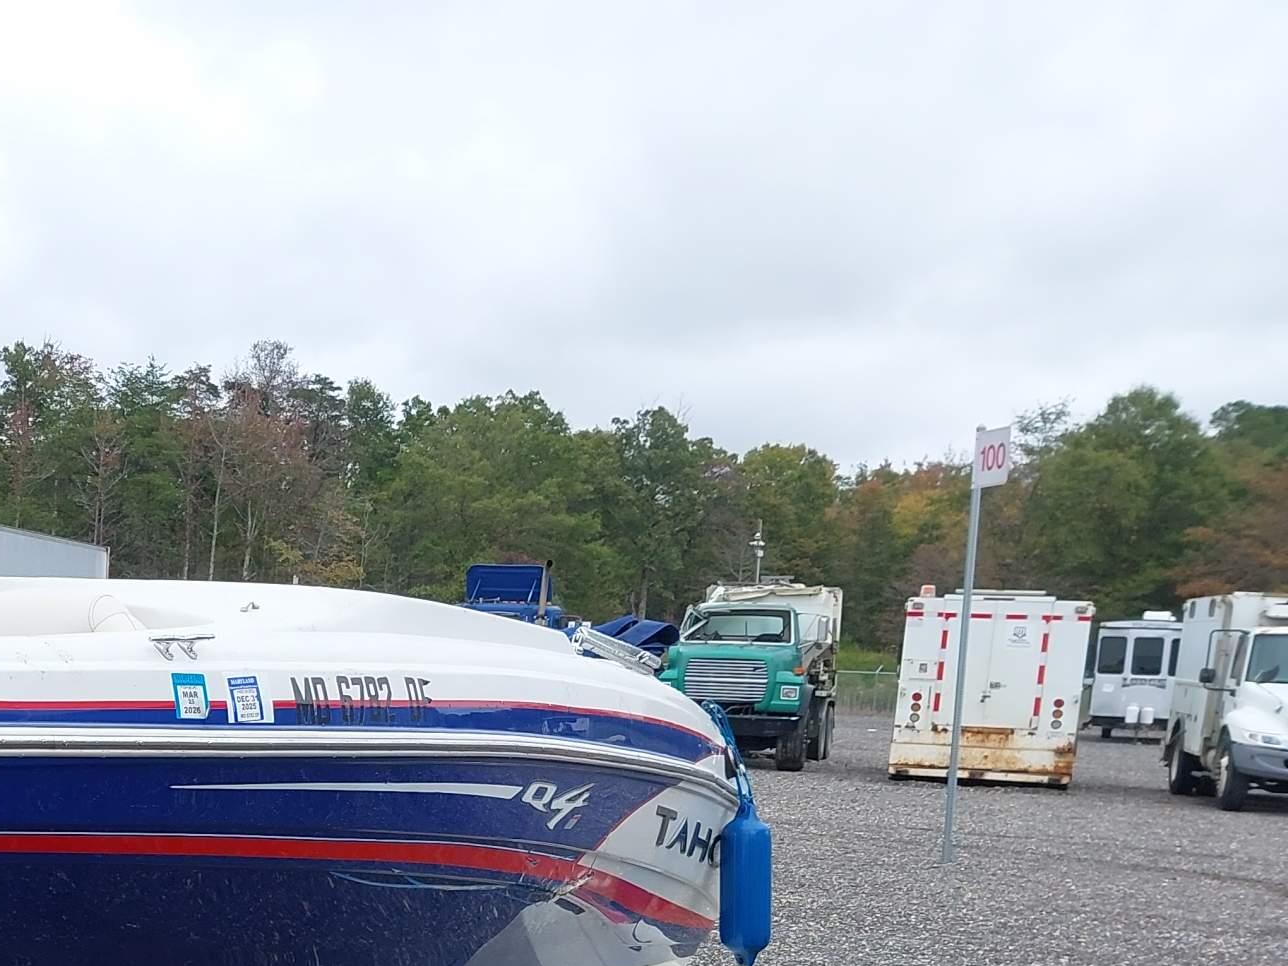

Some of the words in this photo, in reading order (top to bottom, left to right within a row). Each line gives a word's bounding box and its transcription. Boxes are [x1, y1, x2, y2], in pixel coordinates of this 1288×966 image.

[980, 442, 1006, 472] 100
[182, 690, 199, 699] MAR
[236, 695, 250, 703] DEC
[290, 677, 330, 725] MD
[335, 675, 397, 725] 6782
[183, 706, 202, 714] 2026
